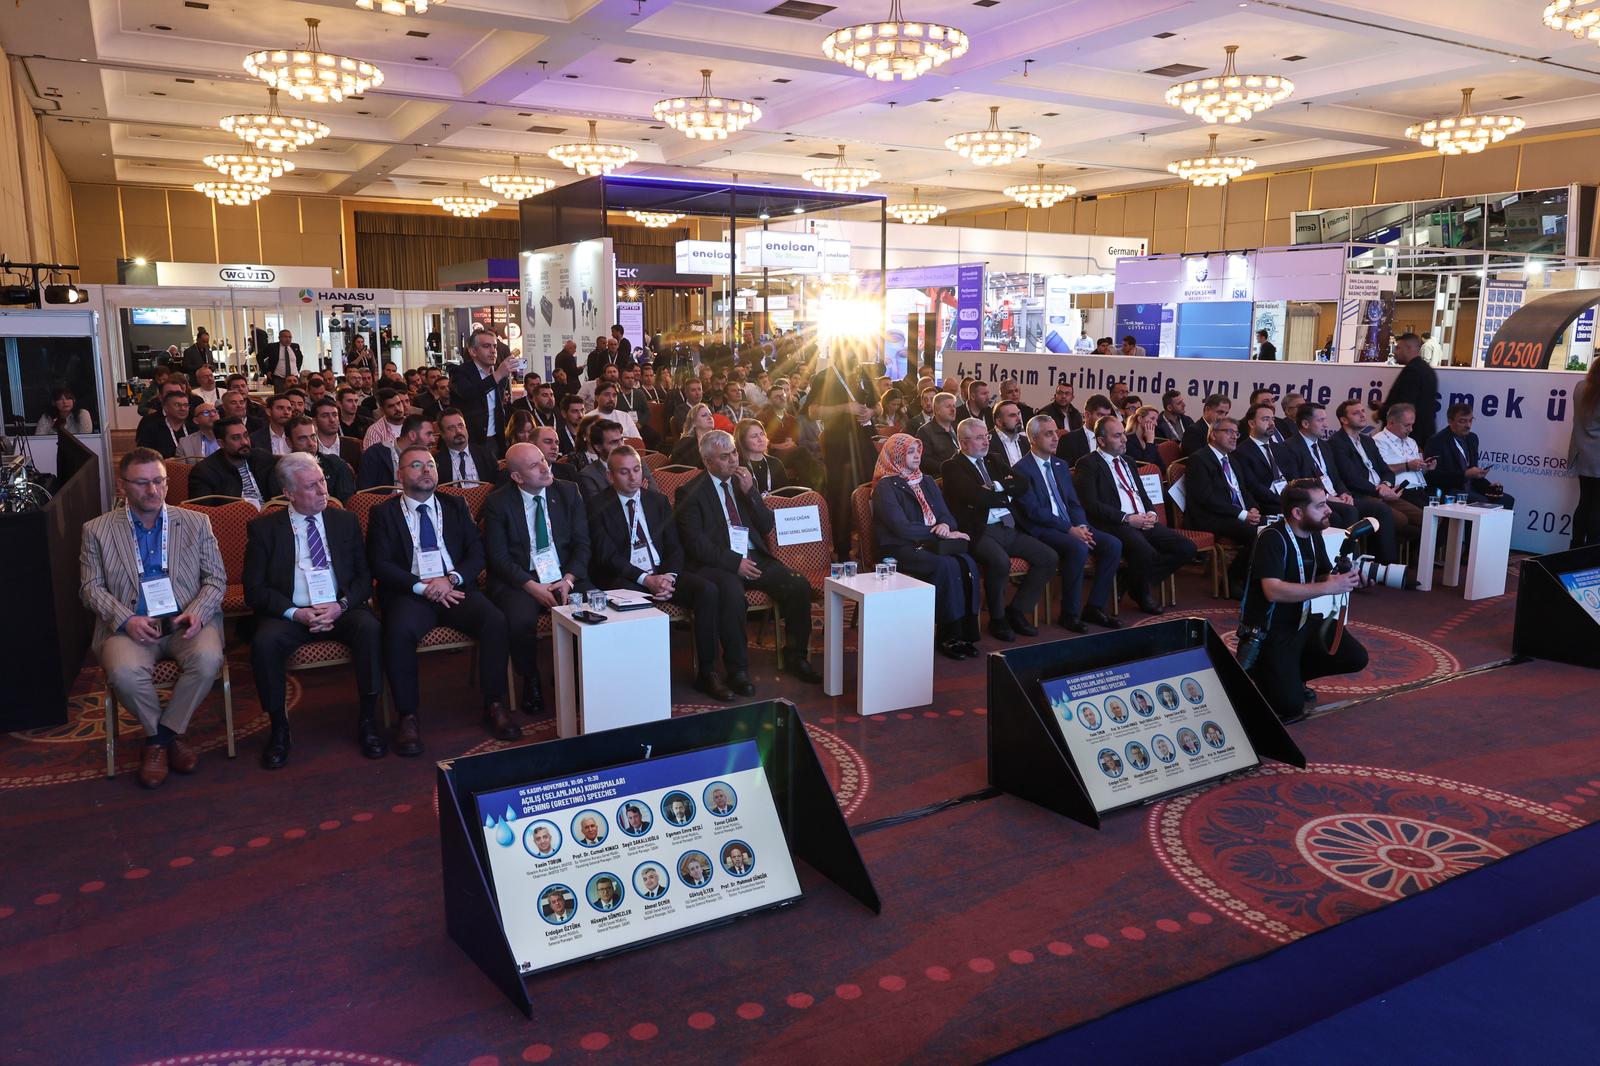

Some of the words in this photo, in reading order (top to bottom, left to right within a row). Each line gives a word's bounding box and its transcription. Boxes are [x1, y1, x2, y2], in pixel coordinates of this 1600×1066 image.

[1108, 246, 1138, 257] Germany
[225, 270, 270, 280] wavin
[318, 292, 374, 300] HANASU
[957, 362, 982, 380] 4-5
[990, 364, 1038, 386] Kasım
[1048, 366, 1176, 394] Tarihlerinde
[1188, 379, 1239, 400] aynı
[1512, 454, 1540, 466] LOSS
[1528, 510, 1572, 536] 202
[520, 794, 542, 805] AÇILIŞ
[541, 785, 584, 801] (SELAMLAMA)
[584, 777, 626, 792] KONUŞMALARI
[522, 801, 551, 814] OPENING
[550, 794, 587, 808] (GREETING)
[586, 788, 617, 800] SPEECHES
[545, 927, 563, 937] Erdoğan
[563, 922, 581, 931] ÖZTÜRK
